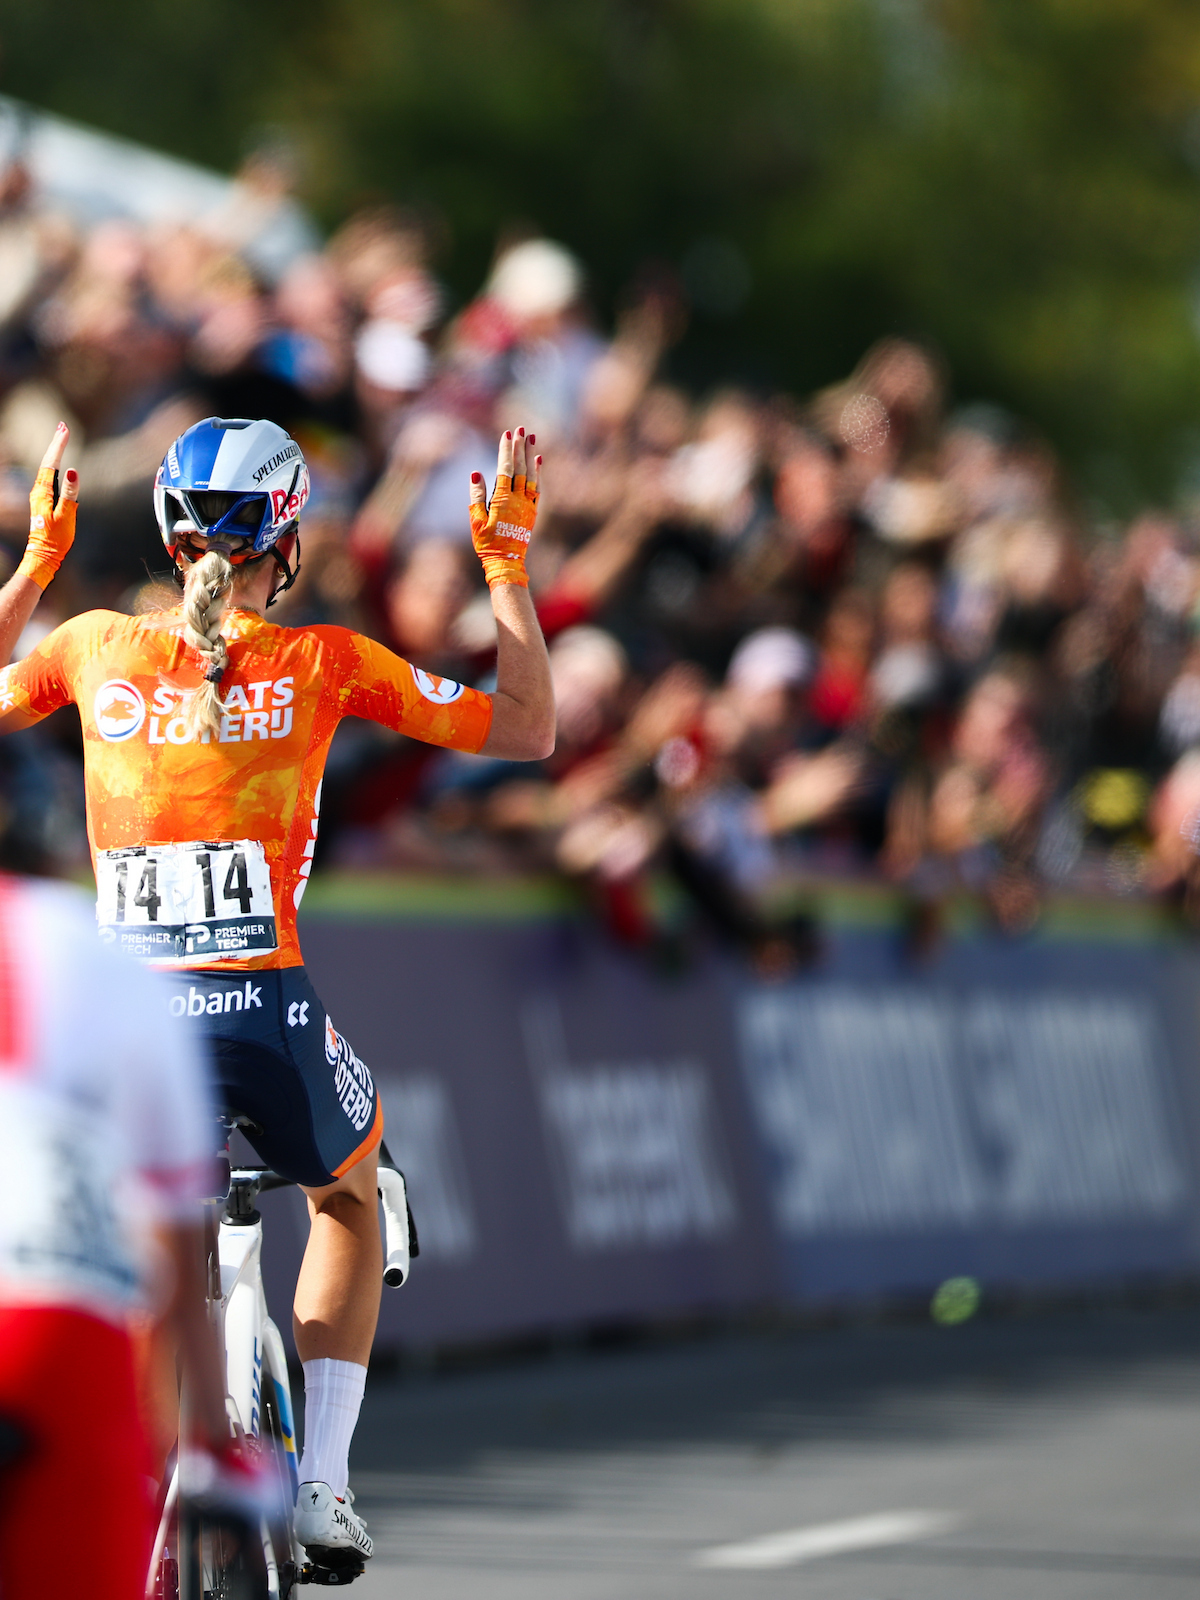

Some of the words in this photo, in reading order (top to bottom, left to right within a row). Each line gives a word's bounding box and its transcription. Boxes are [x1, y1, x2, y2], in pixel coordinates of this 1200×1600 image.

[495, 528, 525, 542] STAATS
[151, 676, 294, 716] STATS
[148, 706, 294, 745] LOERIJ
[115, 858, 162, 922] 14
[195, 852, 253, 918] 14
[120, 932, 171, 945] PREMIER
[215, 924, 266, 940] PREMIER
[215, 937, 248, 950] TECH
[168, 980, 263, 1018] obank
